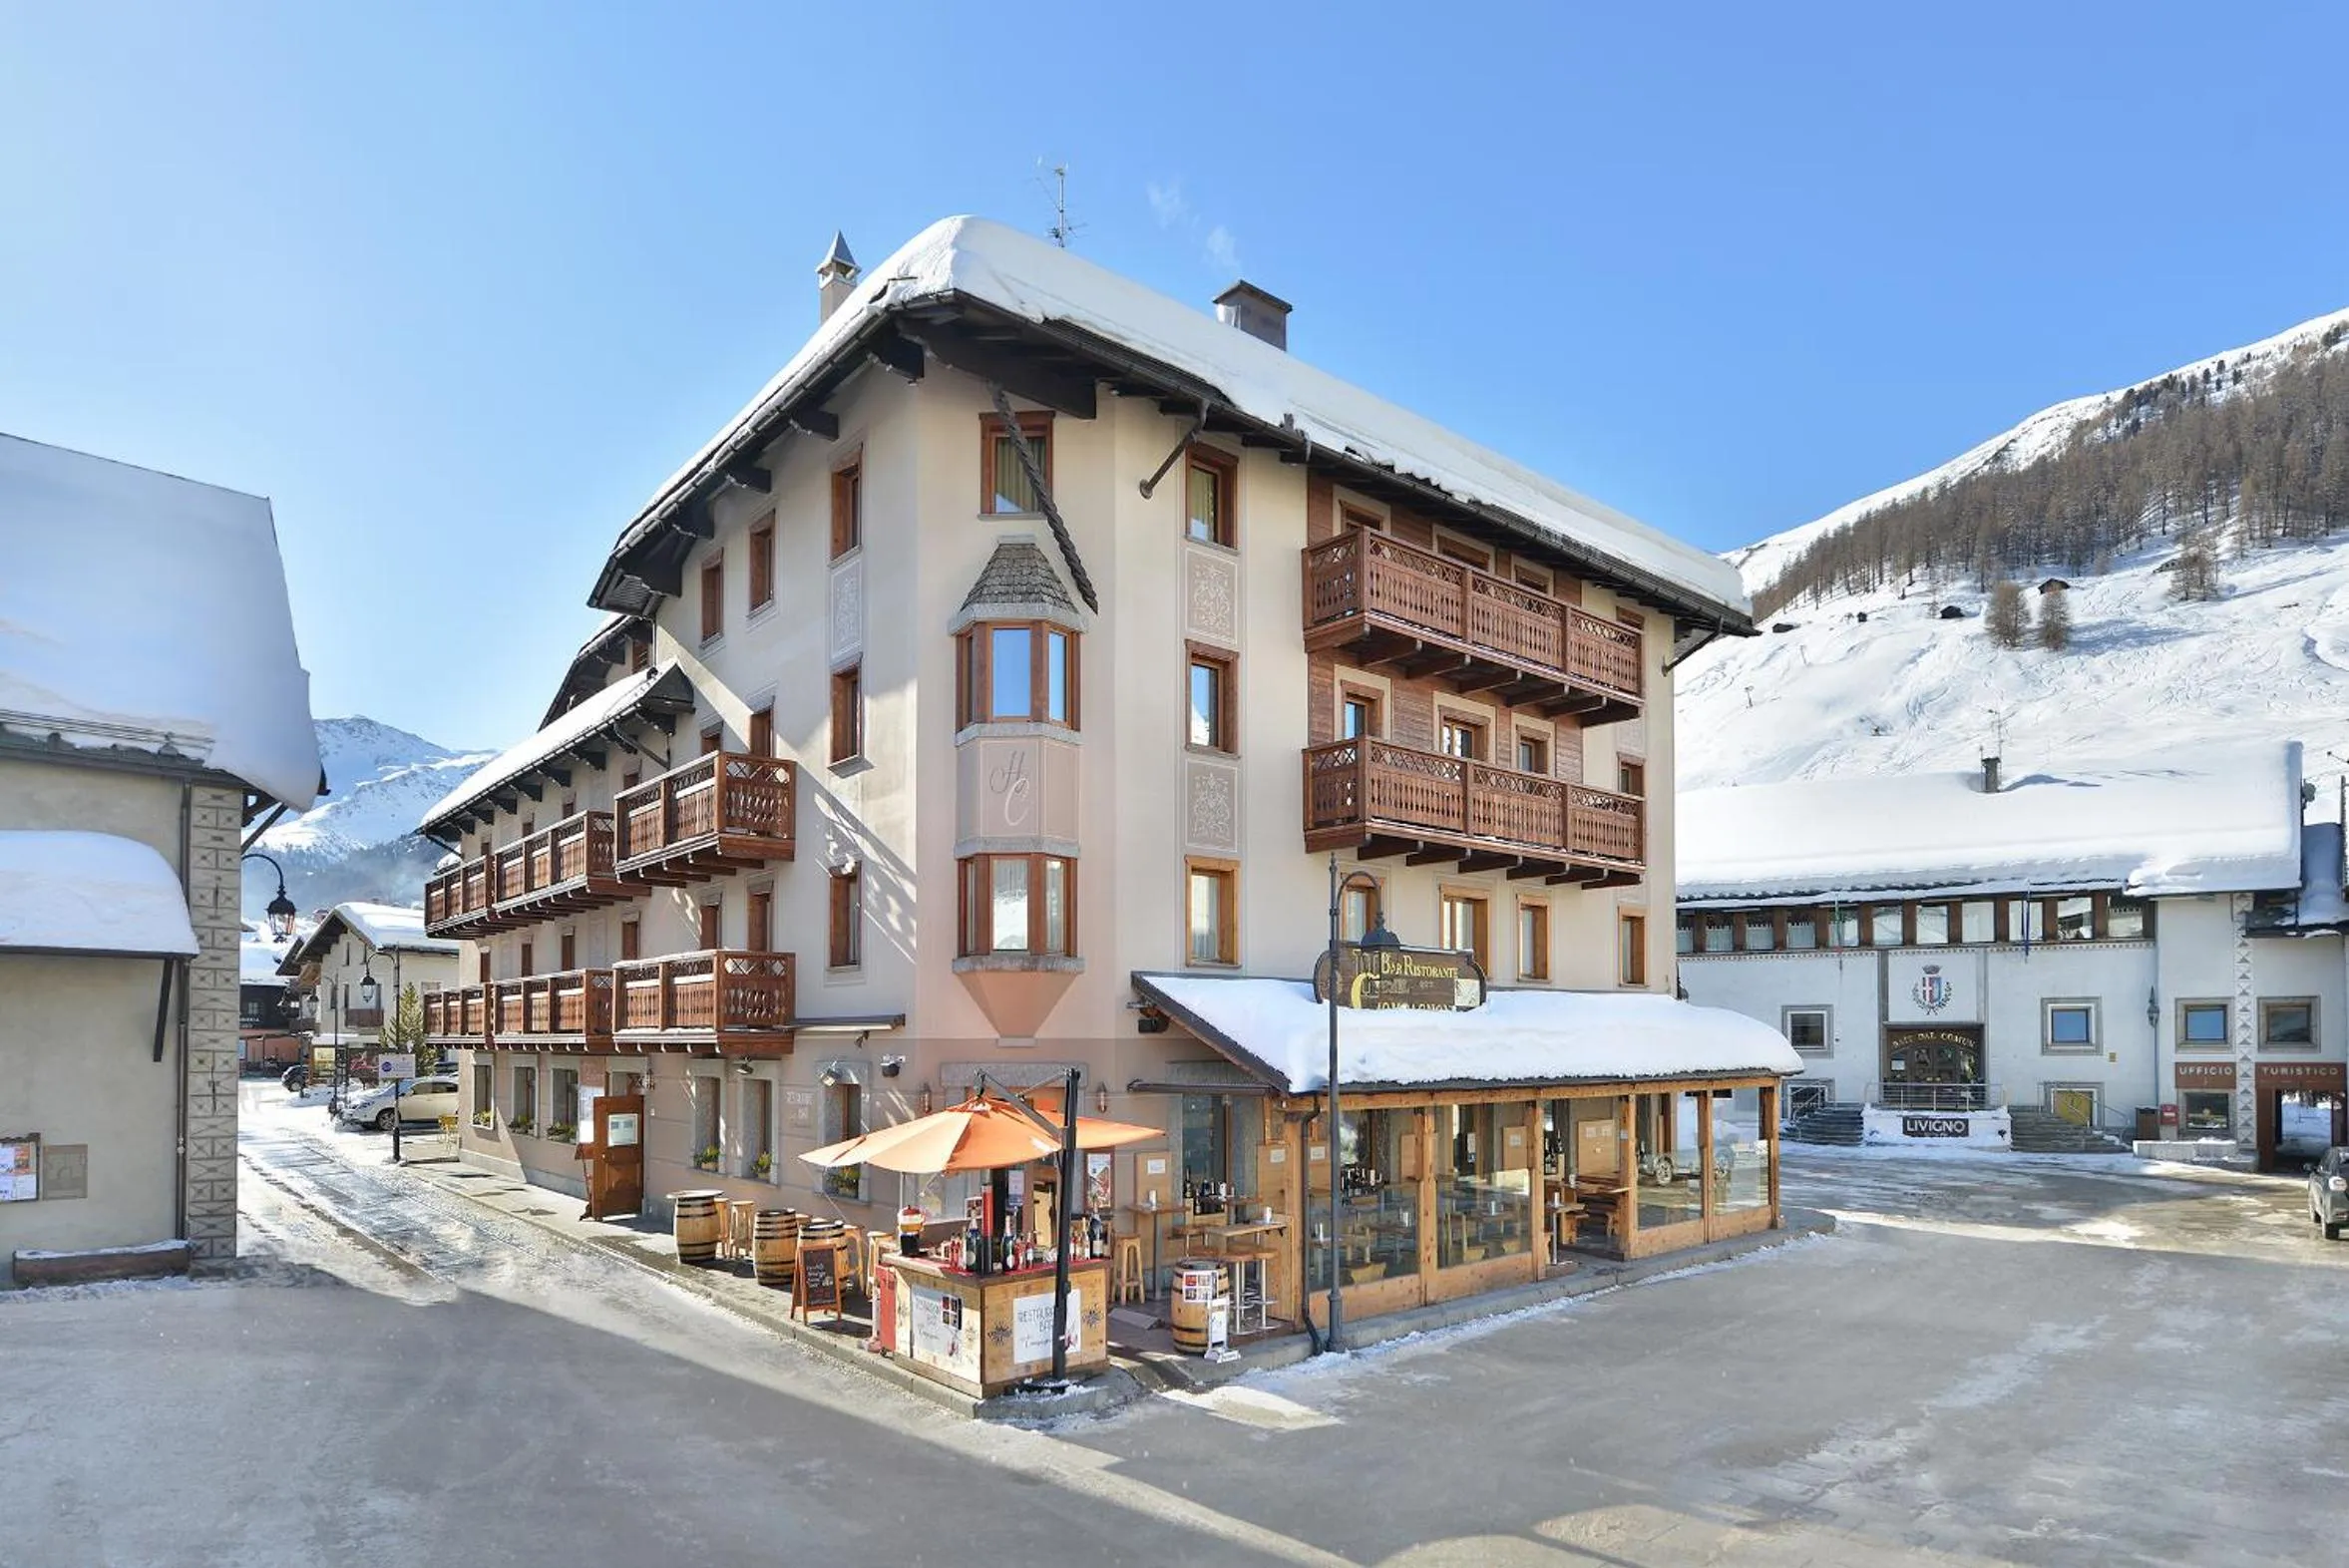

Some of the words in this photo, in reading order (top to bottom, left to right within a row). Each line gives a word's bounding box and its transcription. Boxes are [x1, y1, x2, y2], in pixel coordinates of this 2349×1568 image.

[2178, 1066, 2233, 1076] UFFICIO
[2262, 1066, 2339, 1076] TURISTICO
[1906, 1119, 1966, 1133] LIVIGNO
